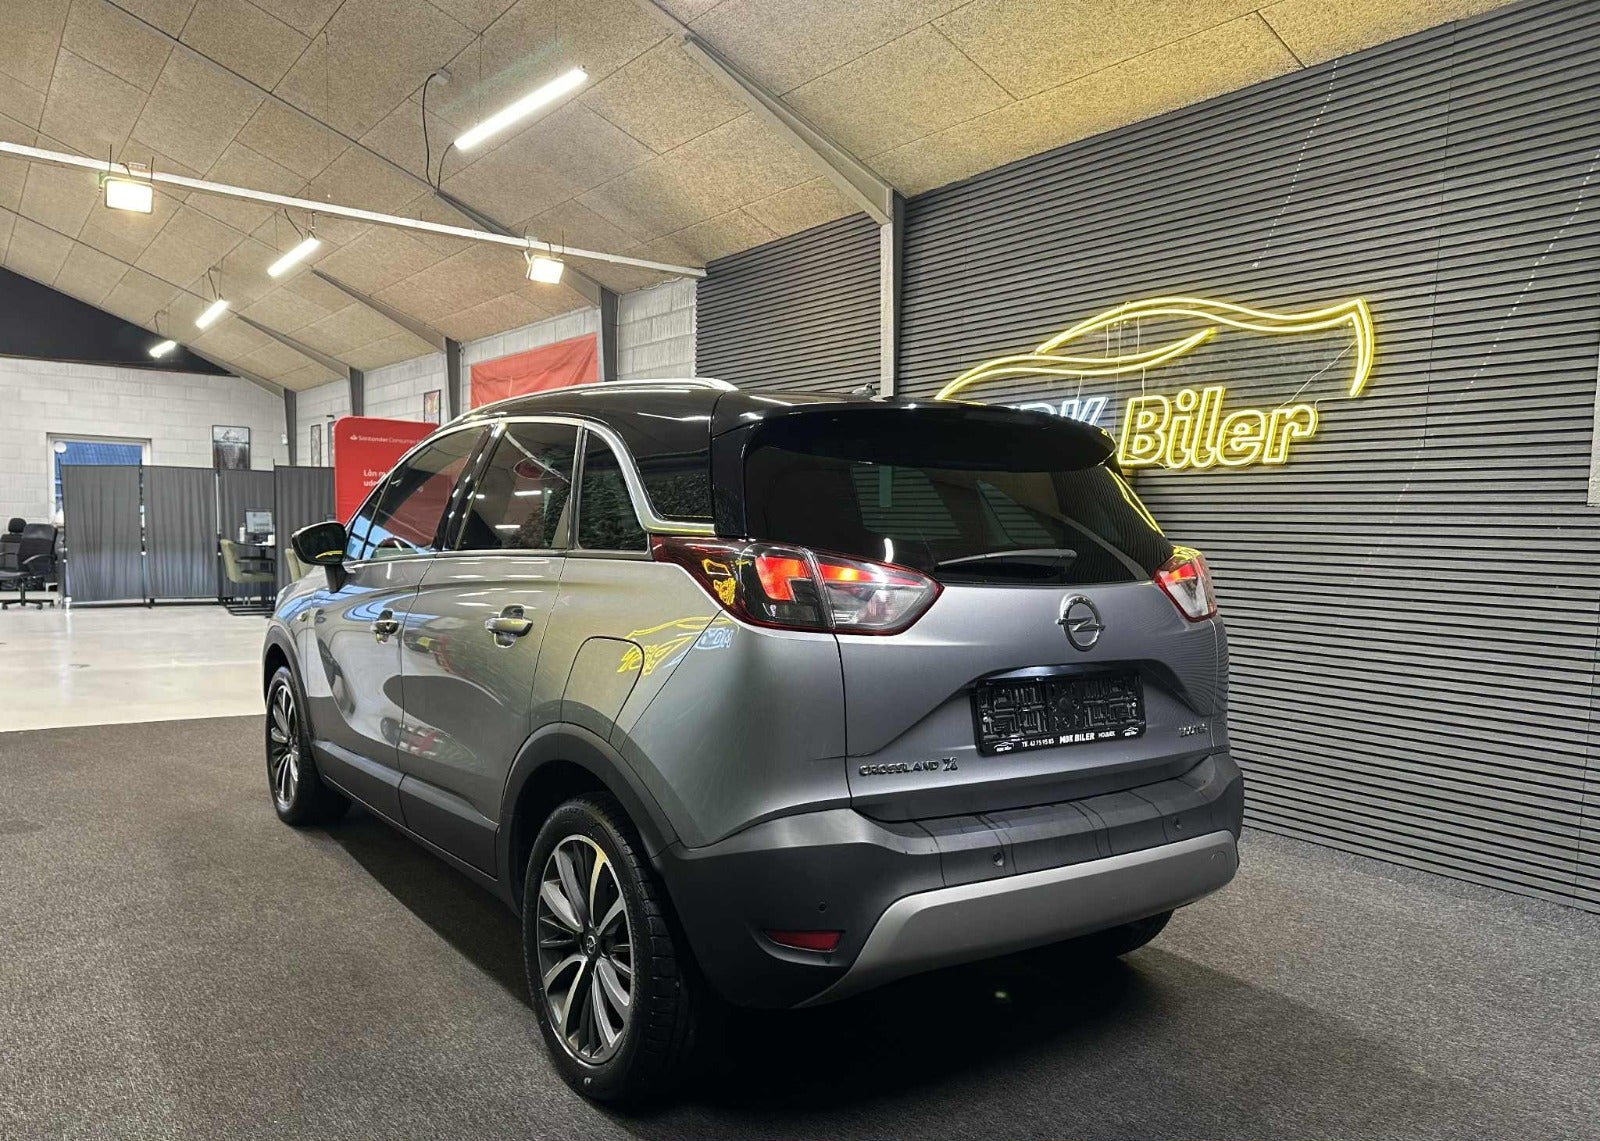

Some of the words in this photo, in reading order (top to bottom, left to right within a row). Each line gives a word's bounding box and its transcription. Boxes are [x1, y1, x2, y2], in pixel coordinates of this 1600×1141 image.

[1119, 386, 1319, 469] Biler
[358, 435, 388, 443] Santander
[363, 468, 377, 477] Lån
[1074, 732, 1095, 742] BILER
[859, 760, 939, 776] CROSSLAND
[942, 756, 958, 772] X
